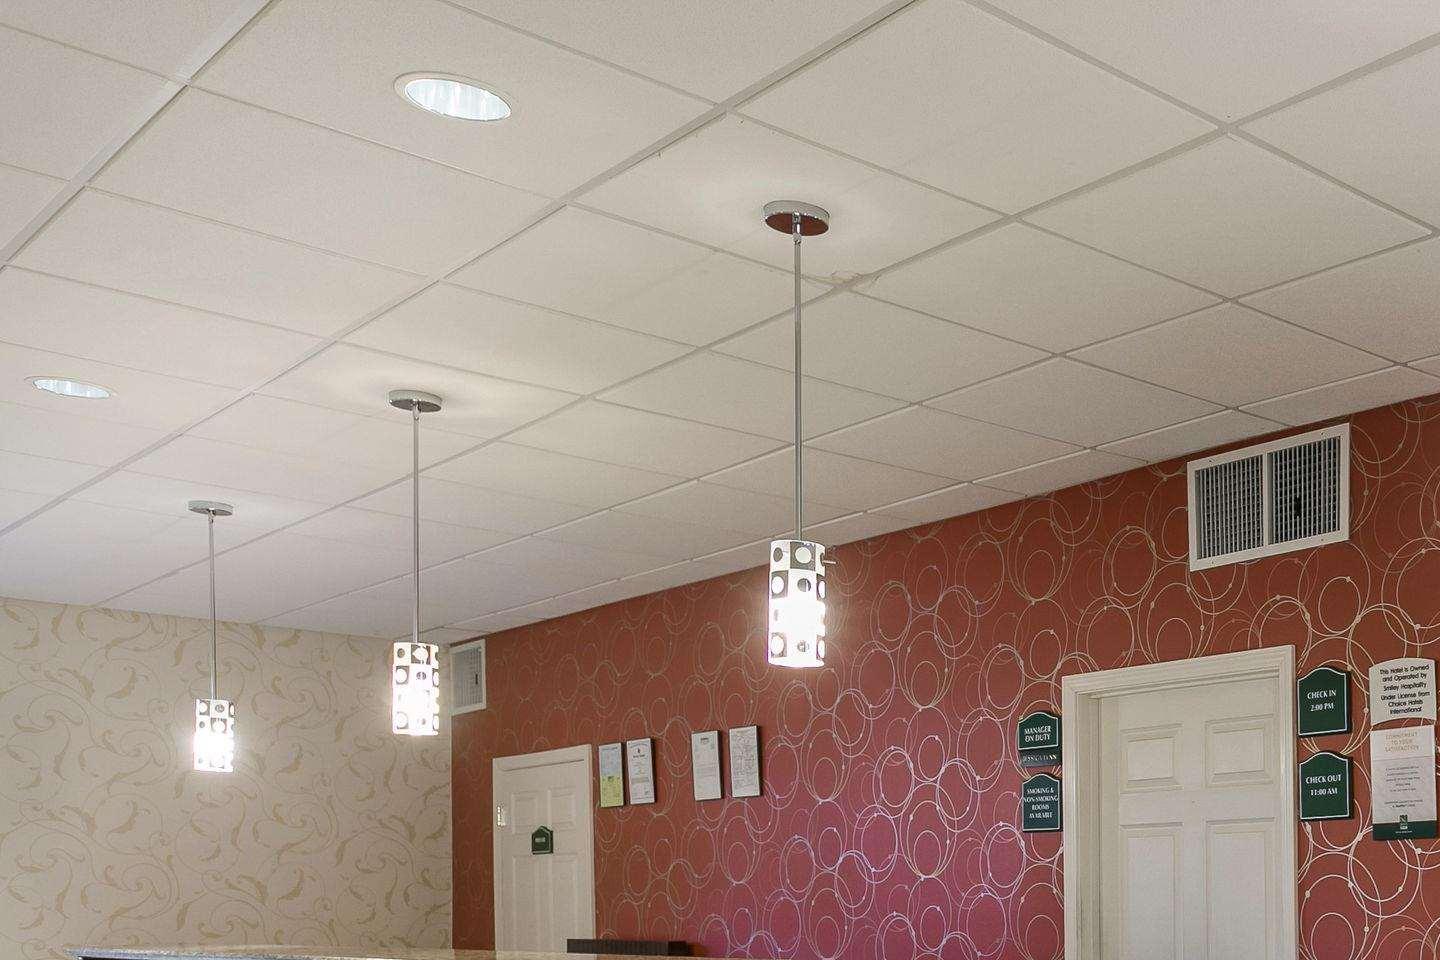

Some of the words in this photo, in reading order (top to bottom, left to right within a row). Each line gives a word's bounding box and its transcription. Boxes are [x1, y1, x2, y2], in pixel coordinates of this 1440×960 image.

[1394, 673, 1419, 681] Operated
[1307, 690, 1328, 699] CHECK
[1329, 689, 1337, 697] IN
[1324, 702, 1334, 710] PM
[1024, 726, 1052, 735] MANAGER
[1035, 733, 1050, 741] DUTY
[1305, 775, 1326, 784] CHECK
[1327, 774, 1342, 782] OUT
[1310, 788, 1326, 796] 11:00
[1327, 787, 1338, 795] AM
